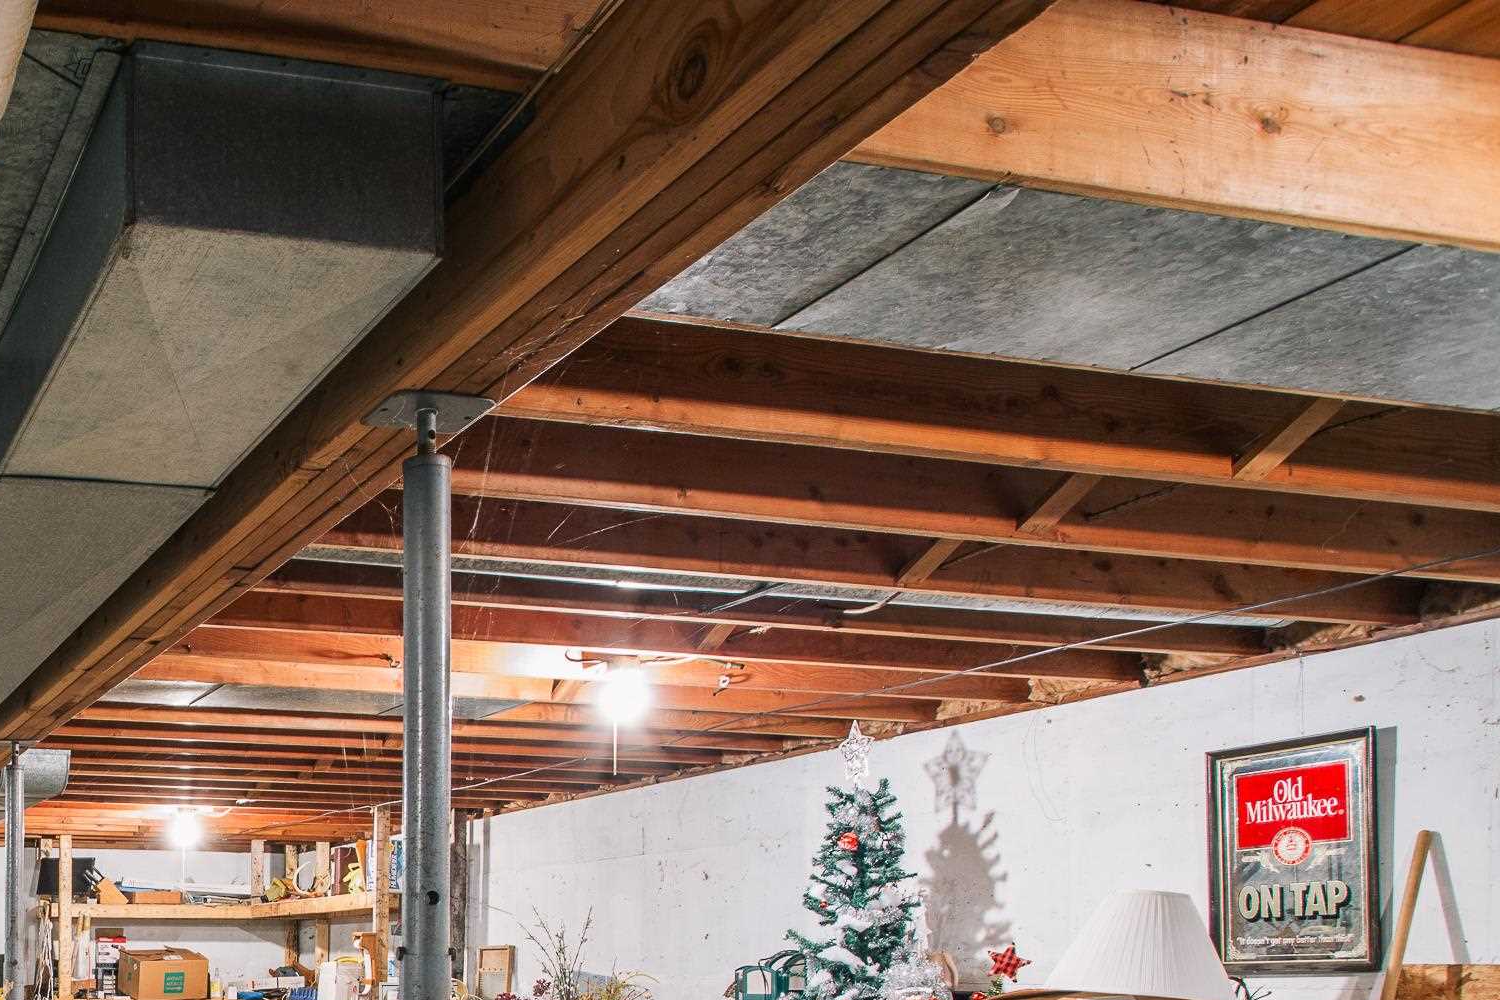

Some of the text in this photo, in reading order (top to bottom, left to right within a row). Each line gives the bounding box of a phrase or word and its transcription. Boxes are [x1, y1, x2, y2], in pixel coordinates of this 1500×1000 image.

[1273, 776, 1305, 803] Old
[1245, 793, 1339, 824] Milwaukee
[1238, 880, 1350, 921] ON TAP
